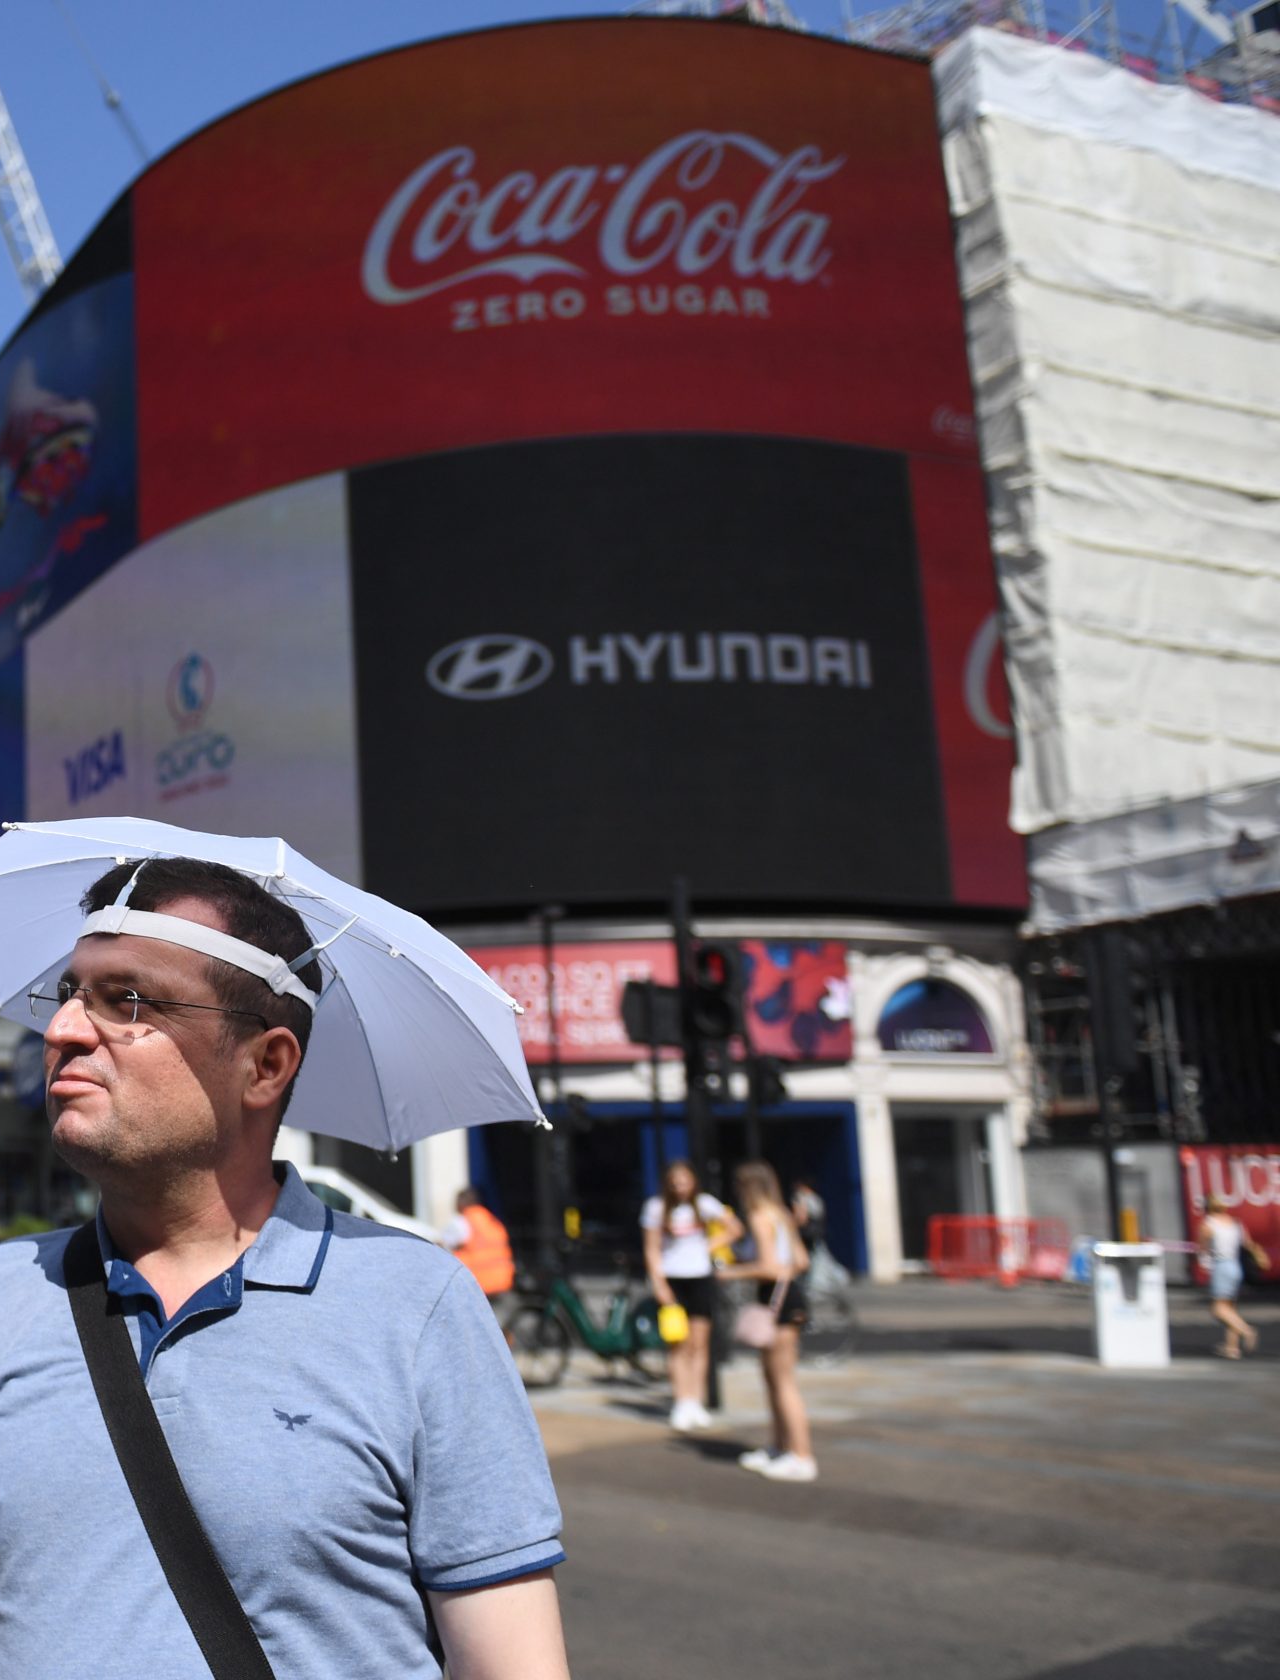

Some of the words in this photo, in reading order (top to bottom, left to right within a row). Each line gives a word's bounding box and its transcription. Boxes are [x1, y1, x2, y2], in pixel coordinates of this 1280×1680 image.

[361, 130, 847, 304] Coca-Cola
[451, 288, 586, 332] ZERO
[606, 283, 771, 318] SUGAR
[568, 631, 873, 690] HYUNDAI
[63, 726, 127, 806] VISA
[566, 961, 613, 992] SQ
